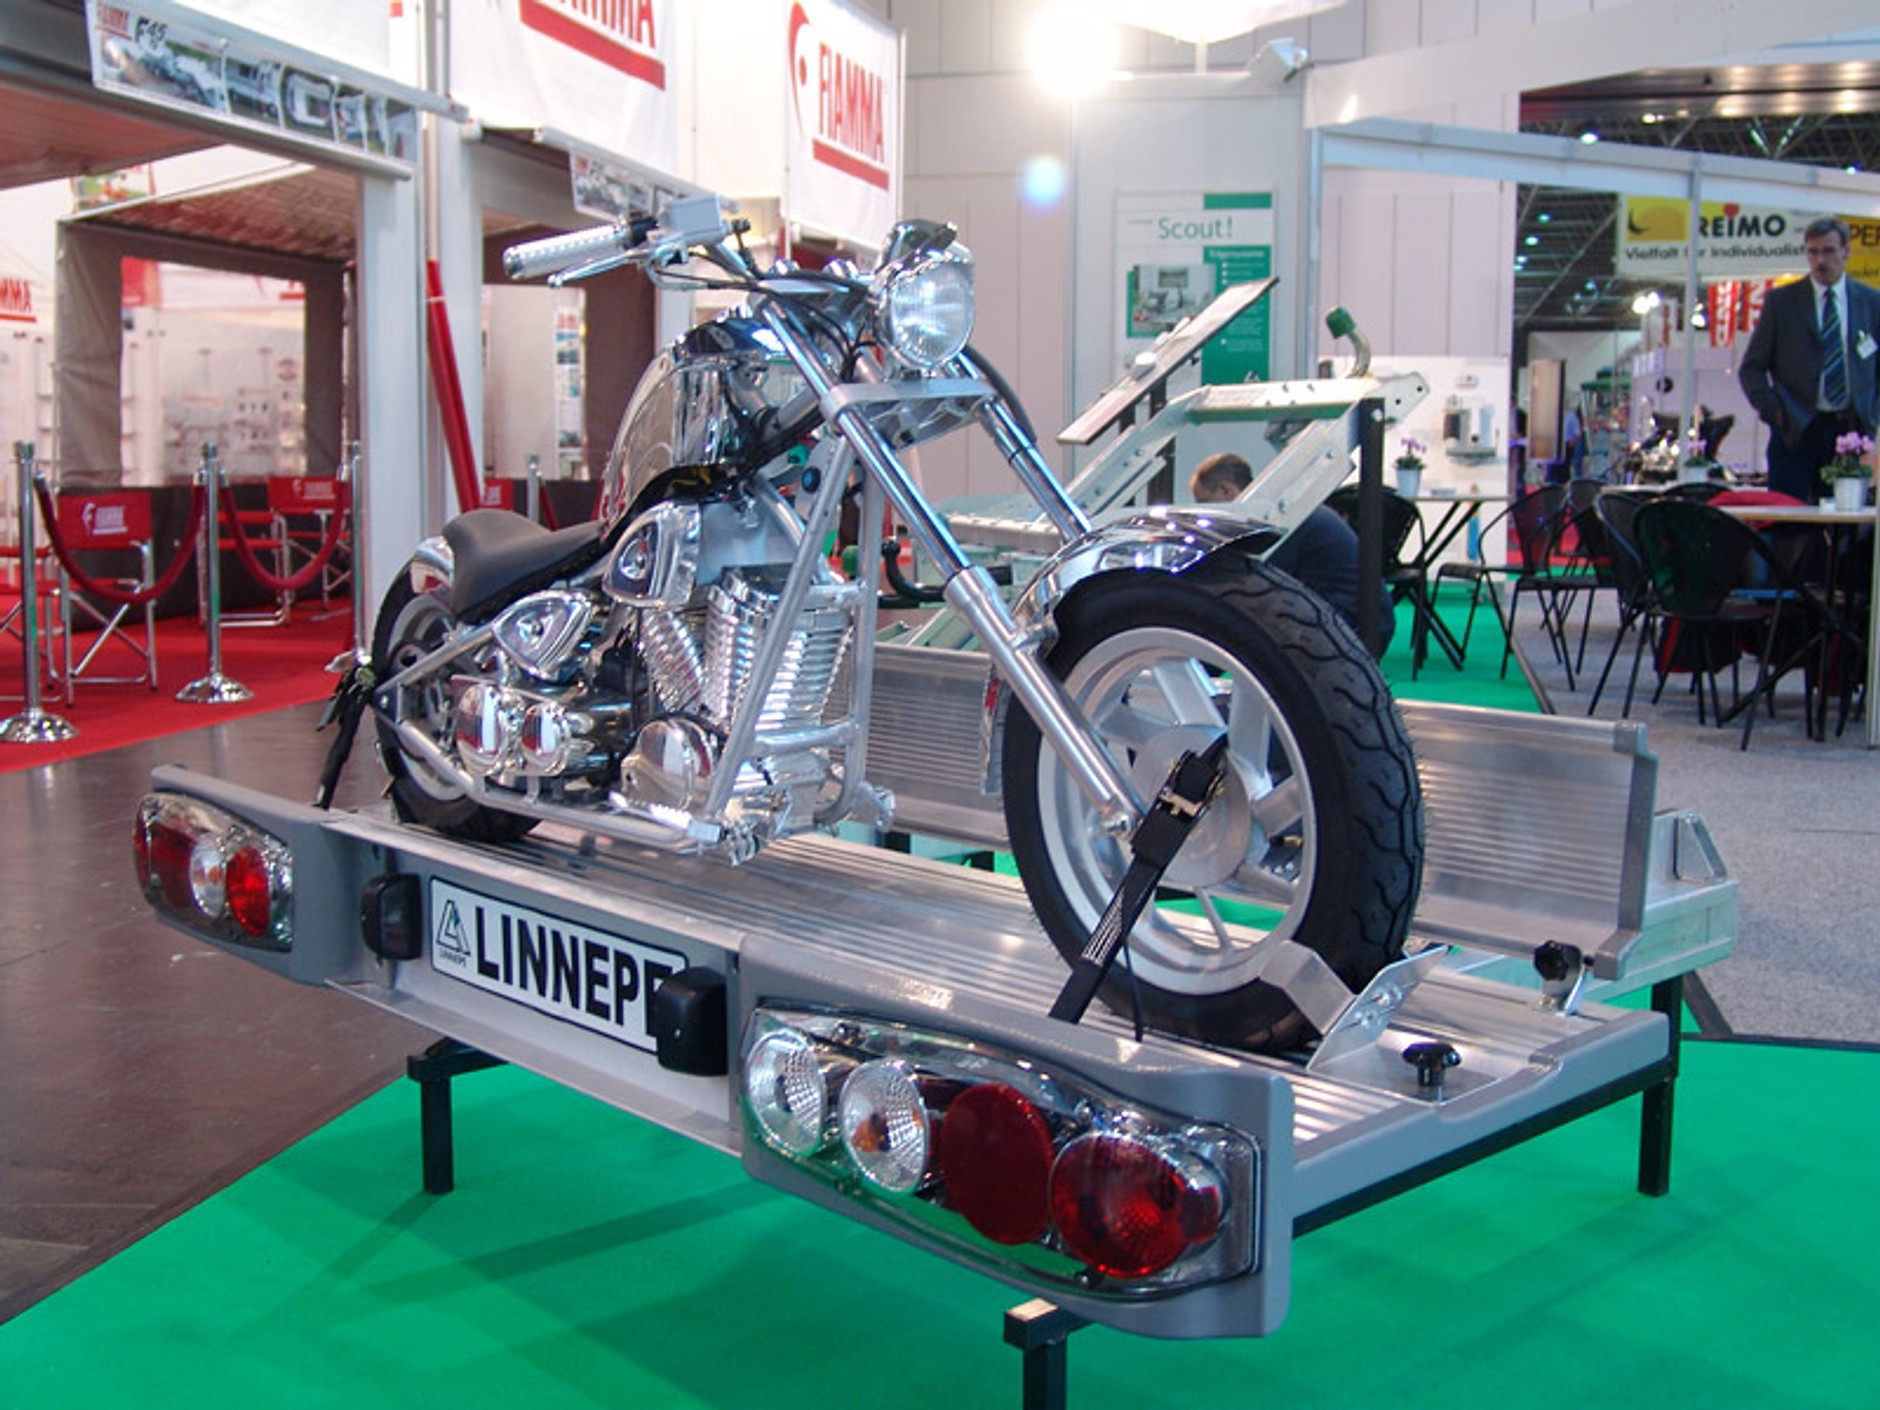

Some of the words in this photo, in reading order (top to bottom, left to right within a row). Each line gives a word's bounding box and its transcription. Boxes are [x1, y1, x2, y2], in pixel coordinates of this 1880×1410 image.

[819, 41, 885, 163] FIAMMA
[1158, 216, 1233, 240] Scout!
[1626, 246, 1679, 259] Vielfalt
[1711, 243, 1807, 258] Individualist
[0, 277, 32, 313] MMA
